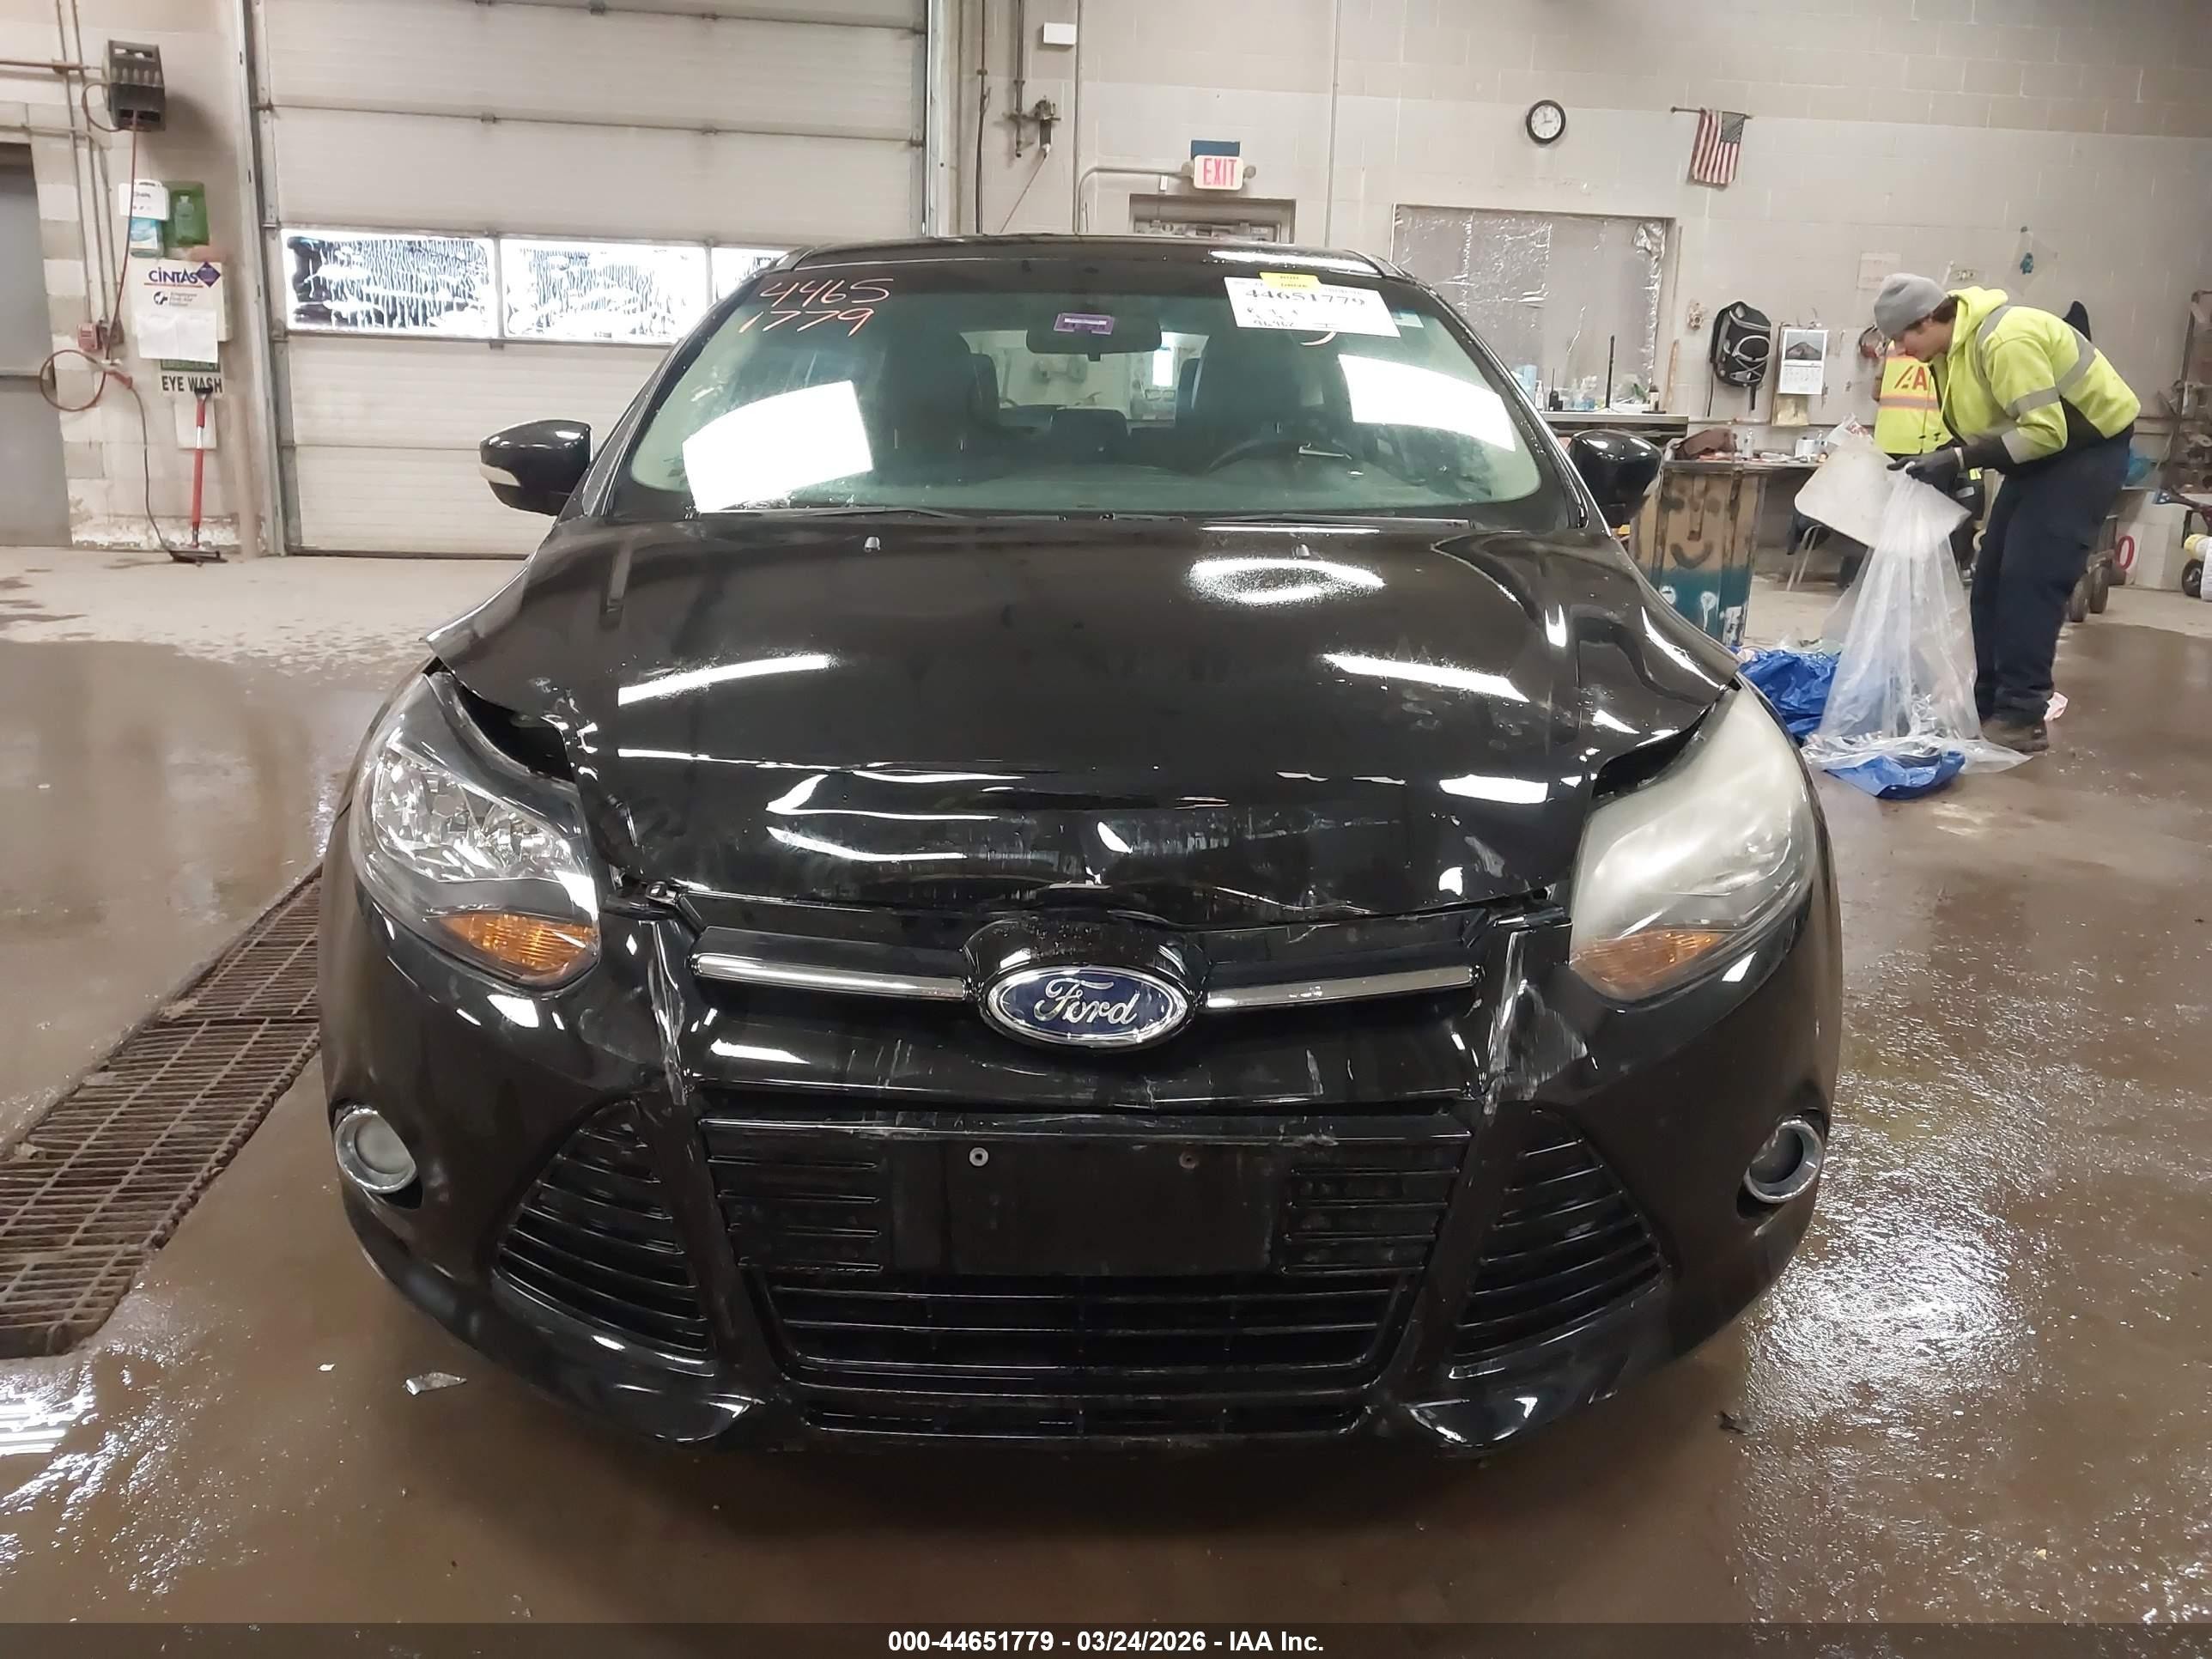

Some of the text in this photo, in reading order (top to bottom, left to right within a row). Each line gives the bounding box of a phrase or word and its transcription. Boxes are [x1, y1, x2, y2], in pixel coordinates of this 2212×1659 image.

[1203, 157, 1237, 187] EXIT
[149, 266, 198, 284] CINTAS
[759, 277, 894, 307] 4465
[738, 307, 874, 337] 1779
[161, 375, 223, 393] EYE WASH
[1033, 977, 1140, 1024] Ford
